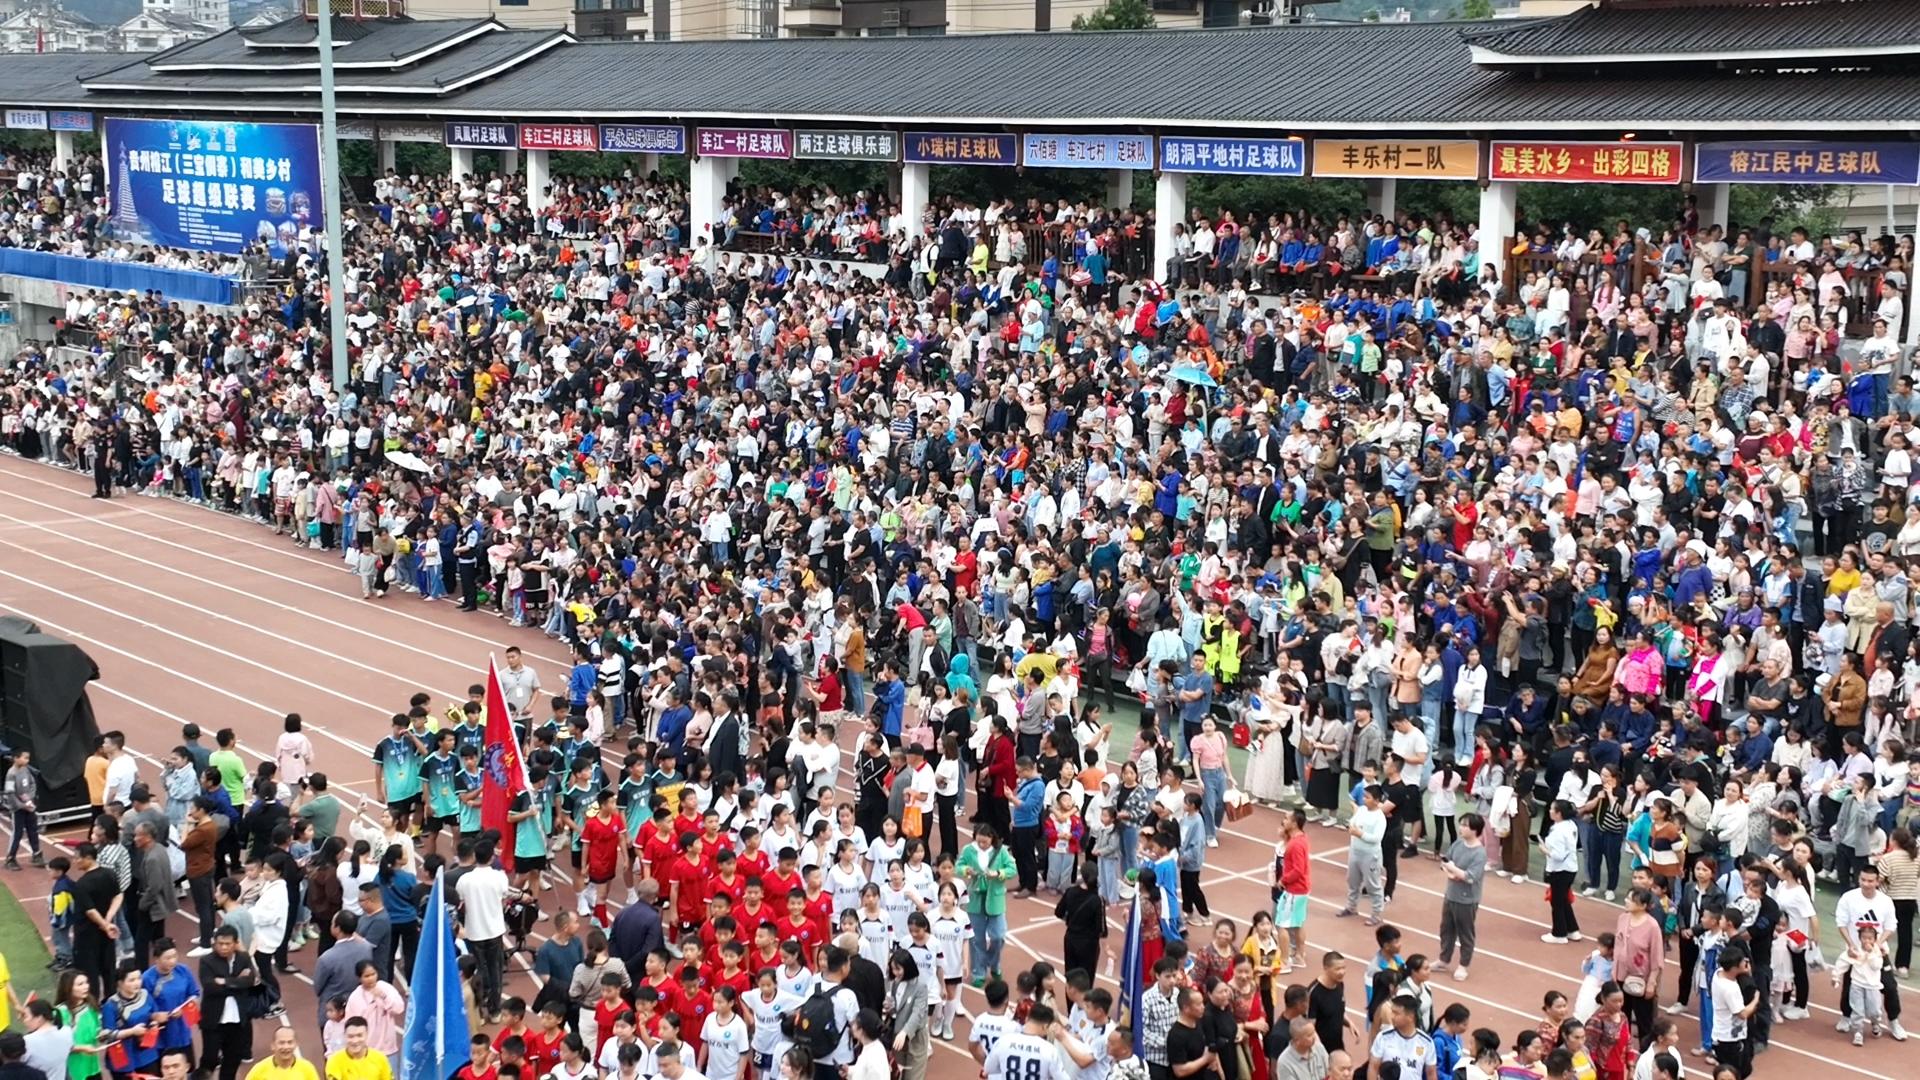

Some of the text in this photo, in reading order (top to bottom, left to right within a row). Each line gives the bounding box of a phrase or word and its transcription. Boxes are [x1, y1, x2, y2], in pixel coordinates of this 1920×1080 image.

[454, 126, 507, 144] 凤凰村足球队
[523, 127, 593, 147] 车江三村足球队
[605, 128, 678, 149] 平永足球俱乐部
[701, 131, 786, 153] 车江一村足球队
[799, 134, 892, 154] 两汪足球俱乐部
[917, 137, 1002, 159] 小瑞村足球队
[1067, 139, 1106, 161] 车江七村
[1116, 141, 1148, 163] 足球队
[1165, 142, 1297, 169] 朗洞平地村足球队
[1342, 146, 1446, 170] 丰乐村二队
[129, 150, 291, 182] 贵州榕江（三宝侗寨）和美乡村
[1730, 151, 1881, 174] 榕江民中足球队
[162, 178, 255, 211] 足球超级联赛
[1006, 1055, 1041, 1080] 88
